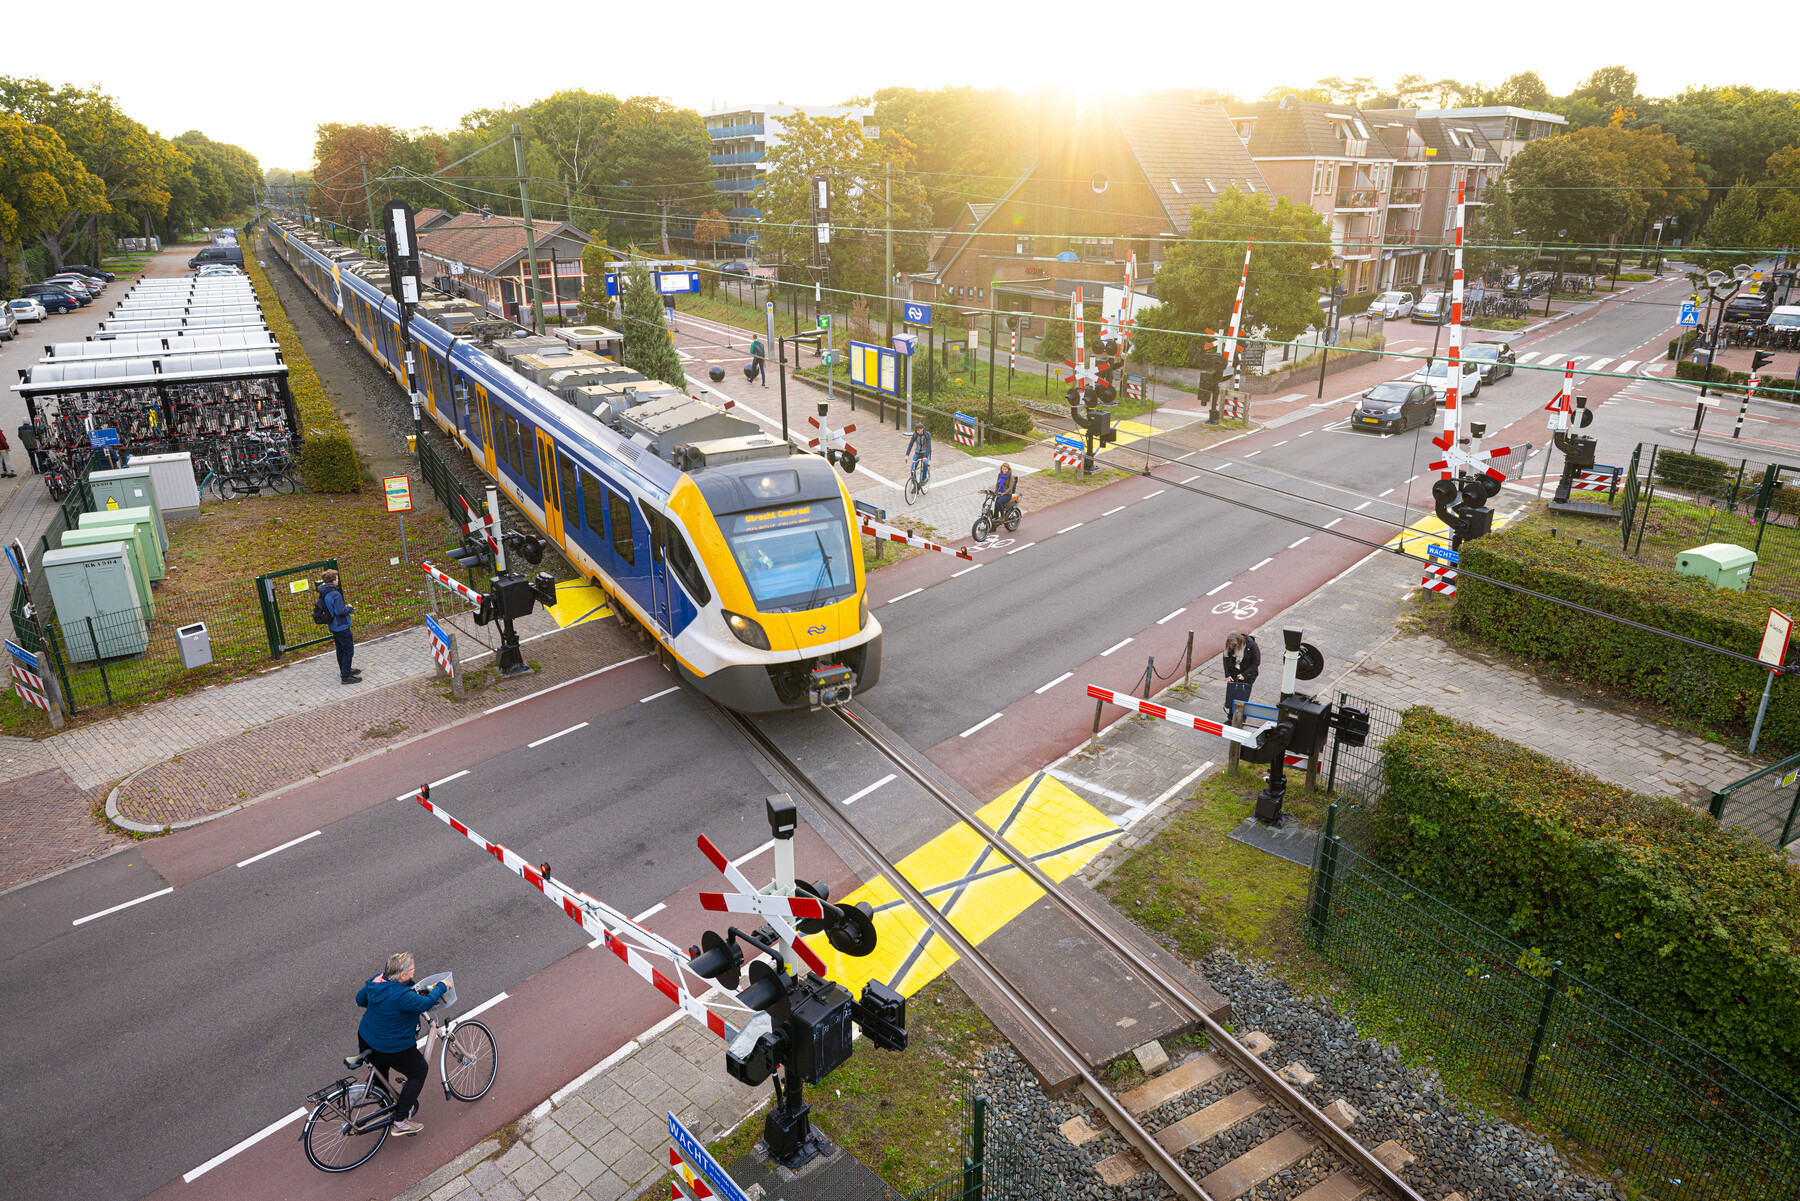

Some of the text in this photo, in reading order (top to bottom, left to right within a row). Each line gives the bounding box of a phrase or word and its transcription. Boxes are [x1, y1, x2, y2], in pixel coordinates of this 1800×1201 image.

[745, 506, 810, 522] Utrecht Centraal
[1429, 547, 1453, 559] WACHT
[669, 1119, 709, 1170] WACHT
